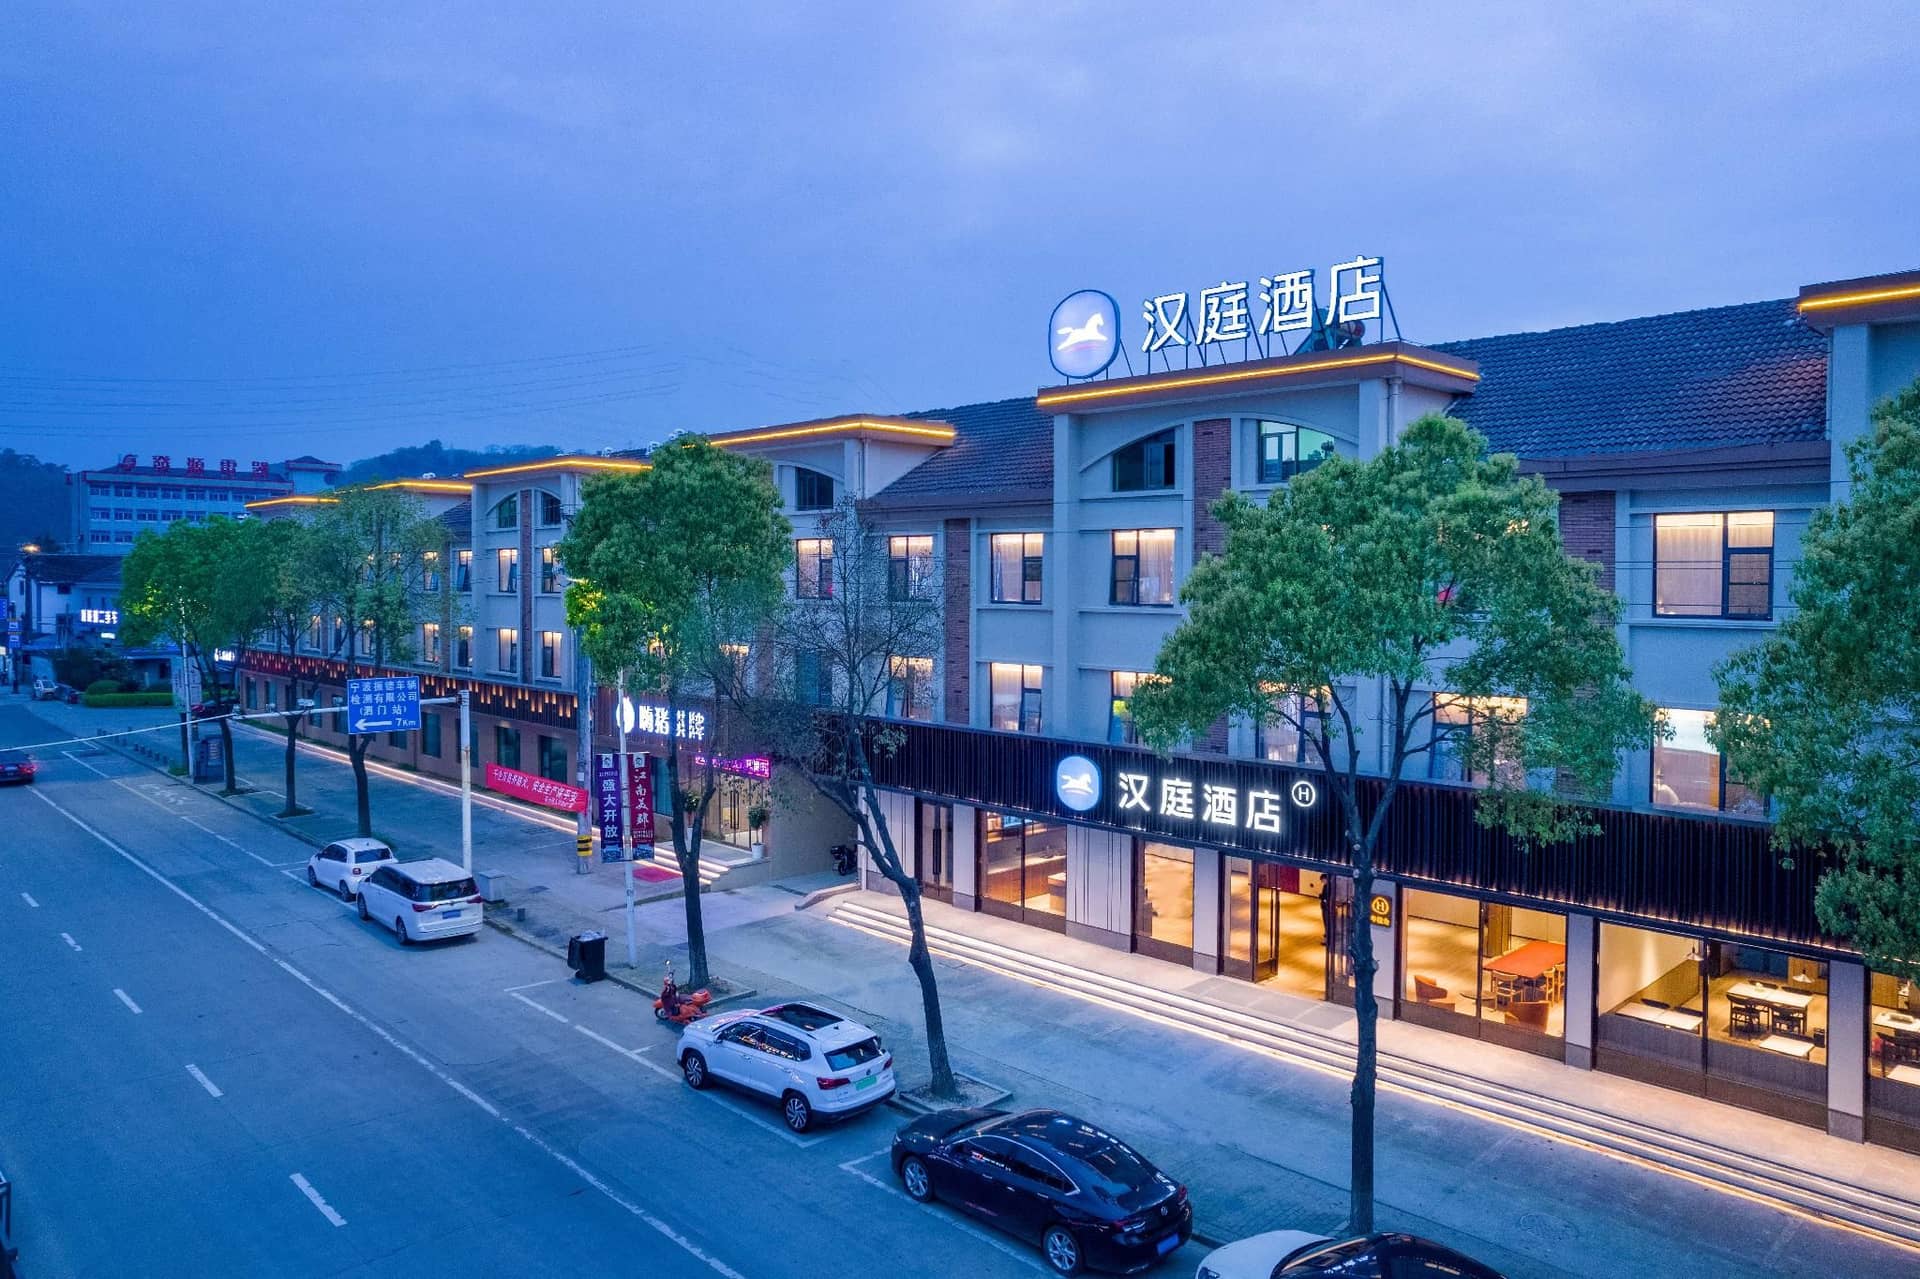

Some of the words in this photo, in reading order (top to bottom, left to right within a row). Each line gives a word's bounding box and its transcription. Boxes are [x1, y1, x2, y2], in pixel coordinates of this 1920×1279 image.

[1141, 255, 1384, 353] 汉庭酒店
[351, 691, 417, 704] 检测有限公司
[602, 779, 619, 838] 盛大开放
[1118, 771, 1282, 834] 汉庭酒店
